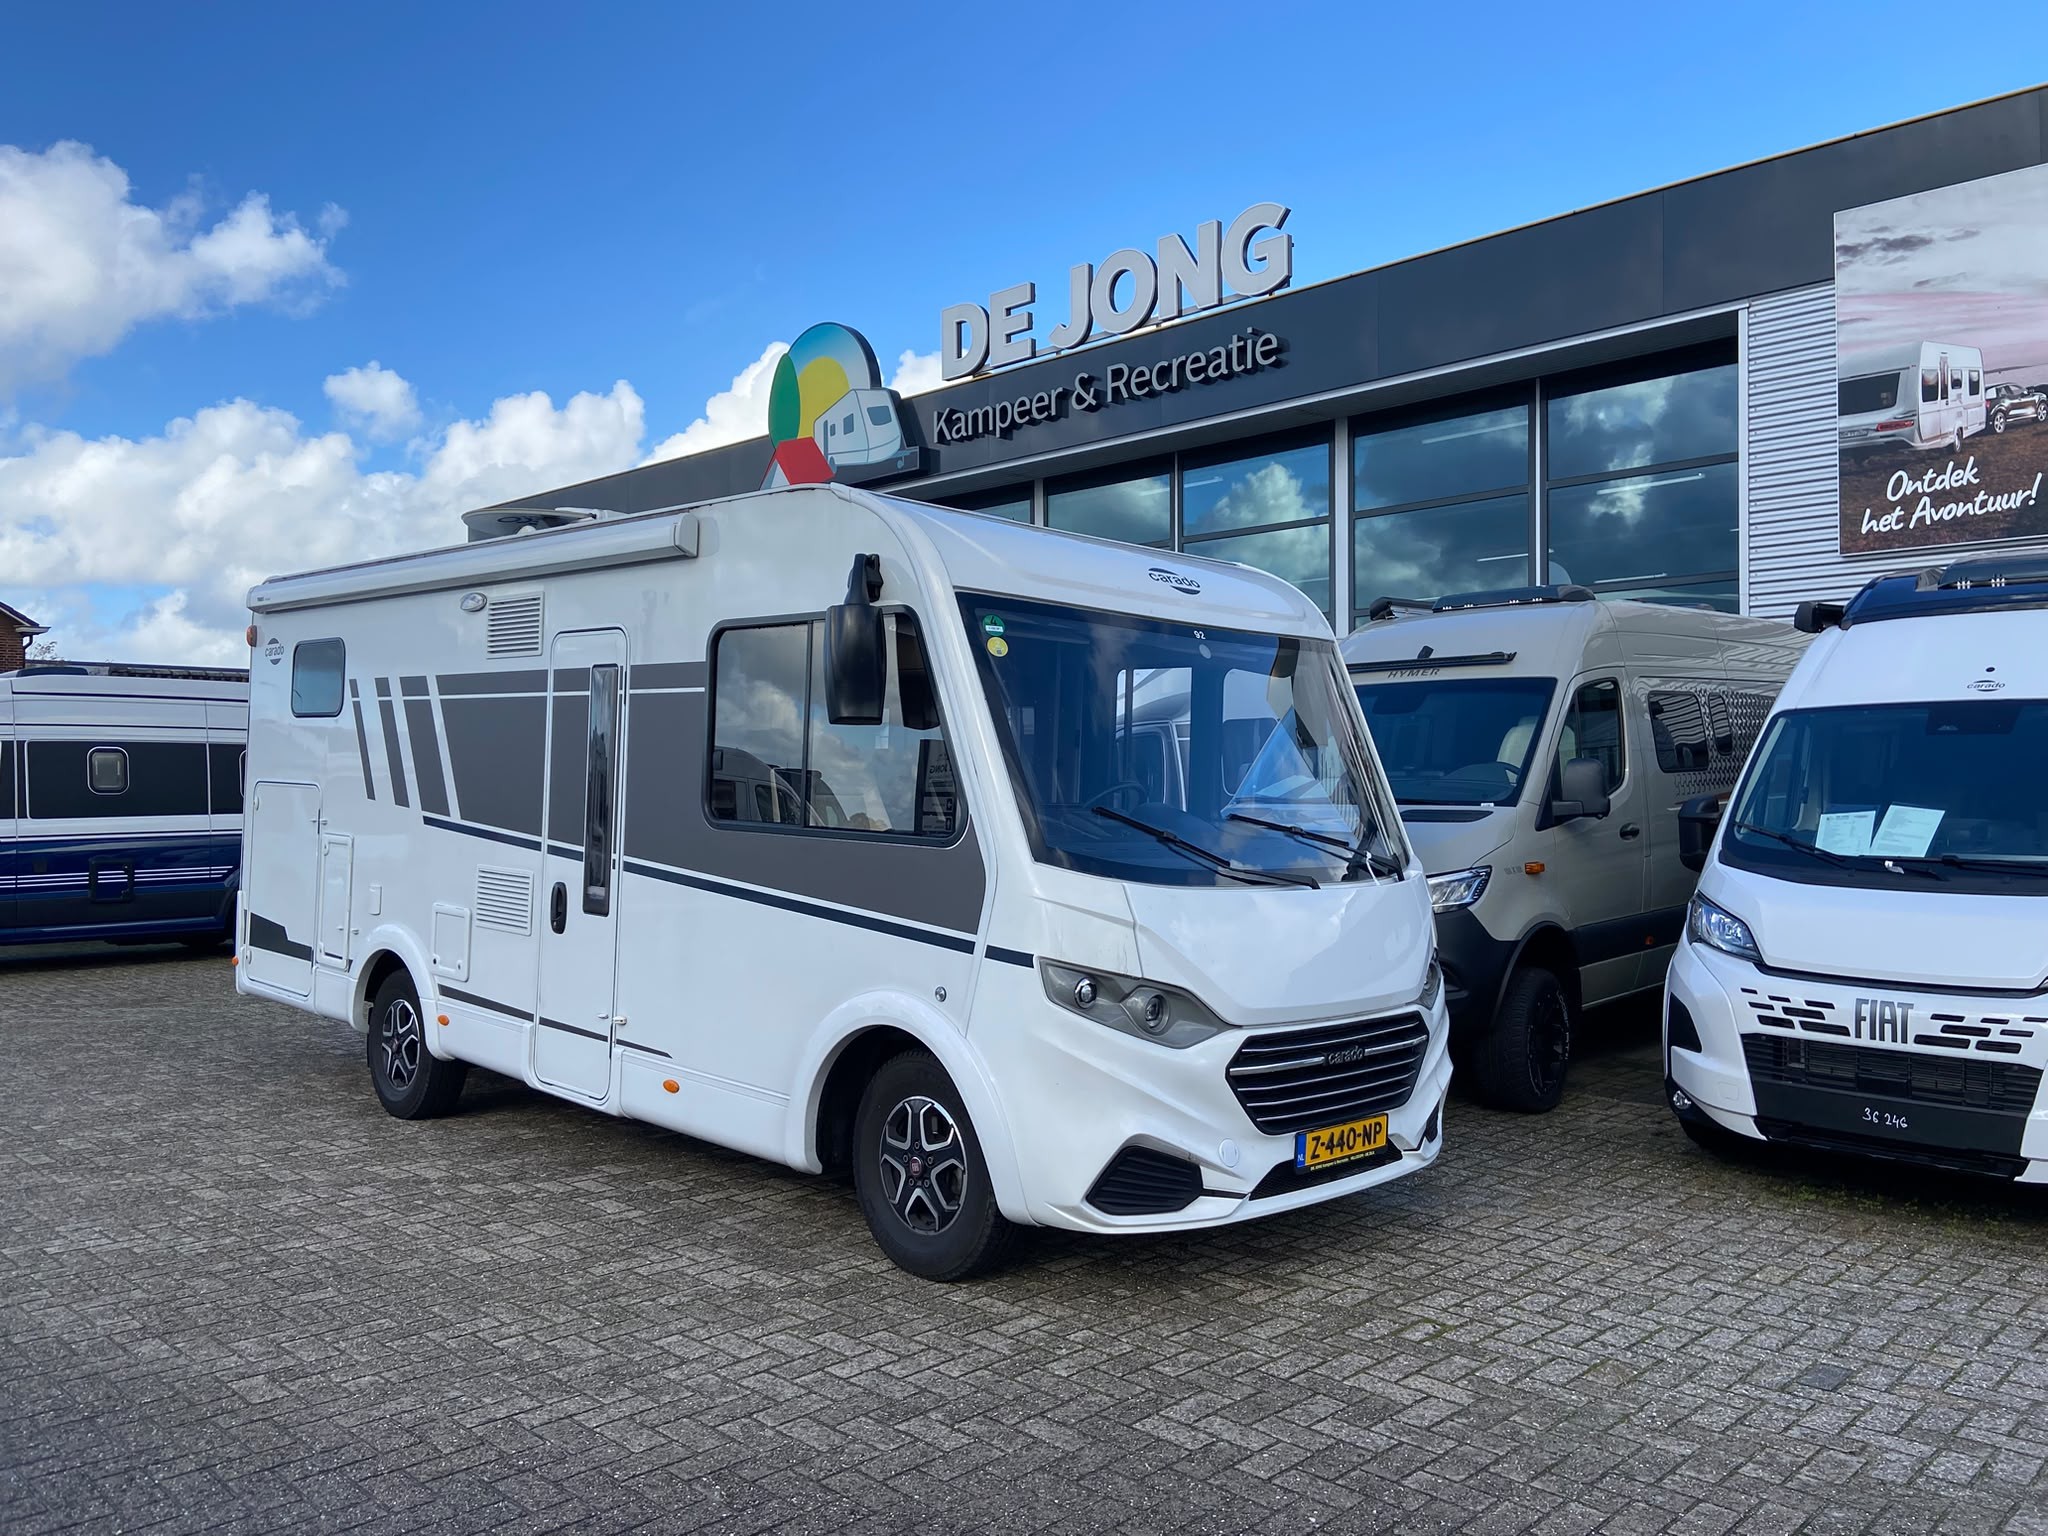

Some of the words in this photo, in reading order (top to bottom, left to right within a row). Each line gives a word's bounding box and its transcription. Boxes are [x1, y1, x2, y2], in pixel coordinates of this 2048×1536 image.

[941, 281, 1036, 381] DE
[1049, 202, 1292, 350] JONG
[933, 387, 1064, 444] Kampeer
[1071, 372, 1097, 411] &
[1106, 326, 1279, 403] Recreatie
[1886, 455, 1980, 502] Ontdek
[1860, 506, 1905, 535] het
[1908, 472, 2043, 530] Avontuur!
[1148, 572, 1201, 588] carado
[1193, 630, 1207, 640] 92
[264, 643, 285, 658] carado
[1387, 668, 1440, 679] HYMER
[1966, 682, 2006, 690] carado
[1854, 997, 1915, 1045] FIAT
[1328, 1044, 1364, 1065] carado
[1862, 1107, 1879, 1124] 36
[1884, 1112, 1908, 1129] 246
[1297, 1153, 1305, 1162] NL
[1310, 1120, 1383, 1161] Z-440-NP
